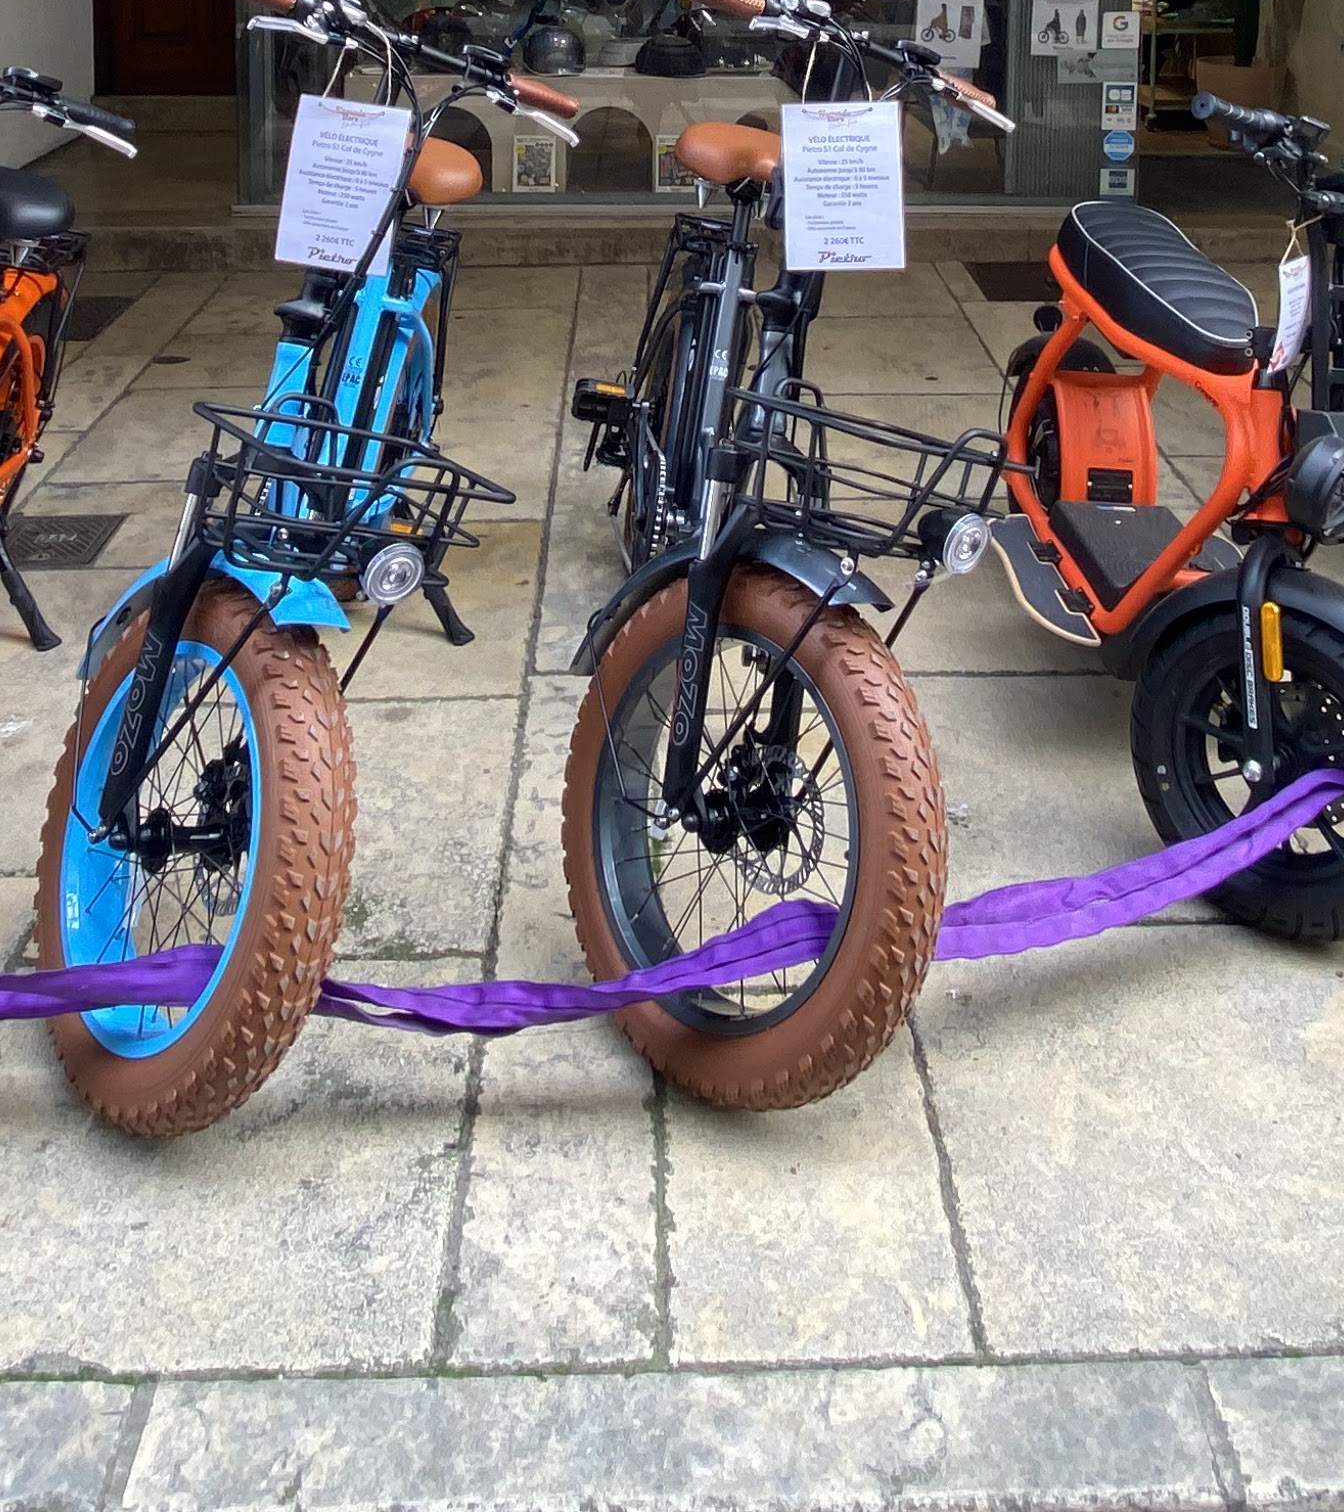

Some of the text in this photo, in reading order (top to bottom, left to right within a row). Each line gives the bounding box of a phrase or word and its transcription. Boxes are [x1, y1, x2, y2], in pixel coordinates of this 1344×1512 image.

[808, 135, 871, 143] VÉLO ÉLECTRIQUE
[340, 238, 355, 248] TTC
[849, 236, 865, 245] TTC
[307, 246, 358, 265] Pietro
[817, 251, 872, 263] Pietro
[348, 356, 362, 367] CE
[672, 601, 708, 746] MOZO
[110, 630, 163, 776] MOZO
